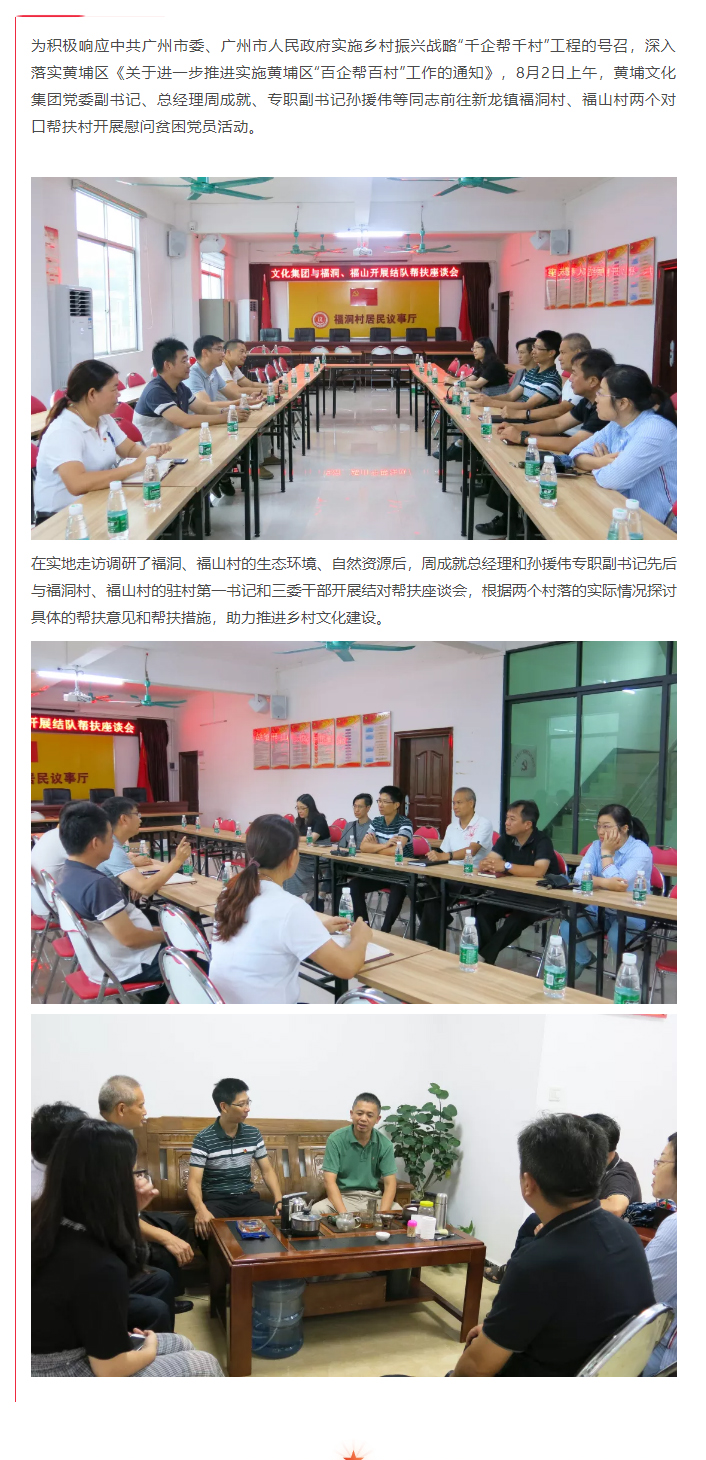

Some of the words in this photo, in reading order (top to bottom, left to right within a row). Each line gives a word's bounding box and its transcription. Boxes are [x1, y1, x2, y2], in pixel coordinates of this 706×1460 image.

[271, 267, 459, 279] 文化集团与福洞、福山开展结队帮扶座谈会
[334, 313, 417, 325] 福洞村居民议事厅
